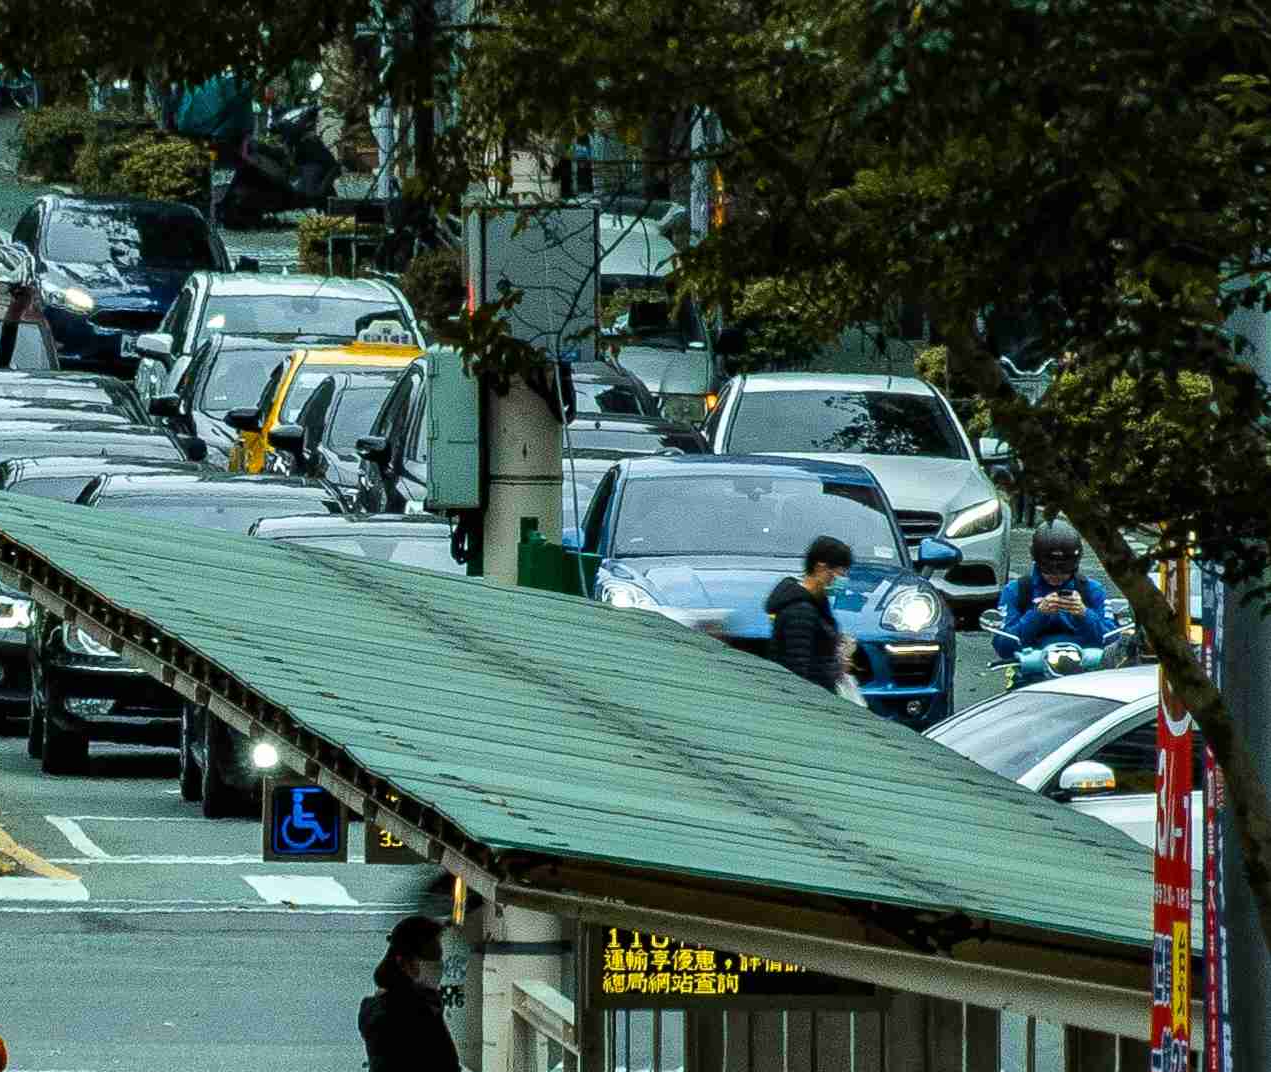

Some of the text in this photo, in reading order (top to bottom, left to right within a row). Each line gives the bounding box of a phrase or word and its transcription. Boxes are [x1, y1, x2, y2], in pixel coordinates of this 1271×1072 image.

[602, 972, 739, 994] 總局網站查詢
